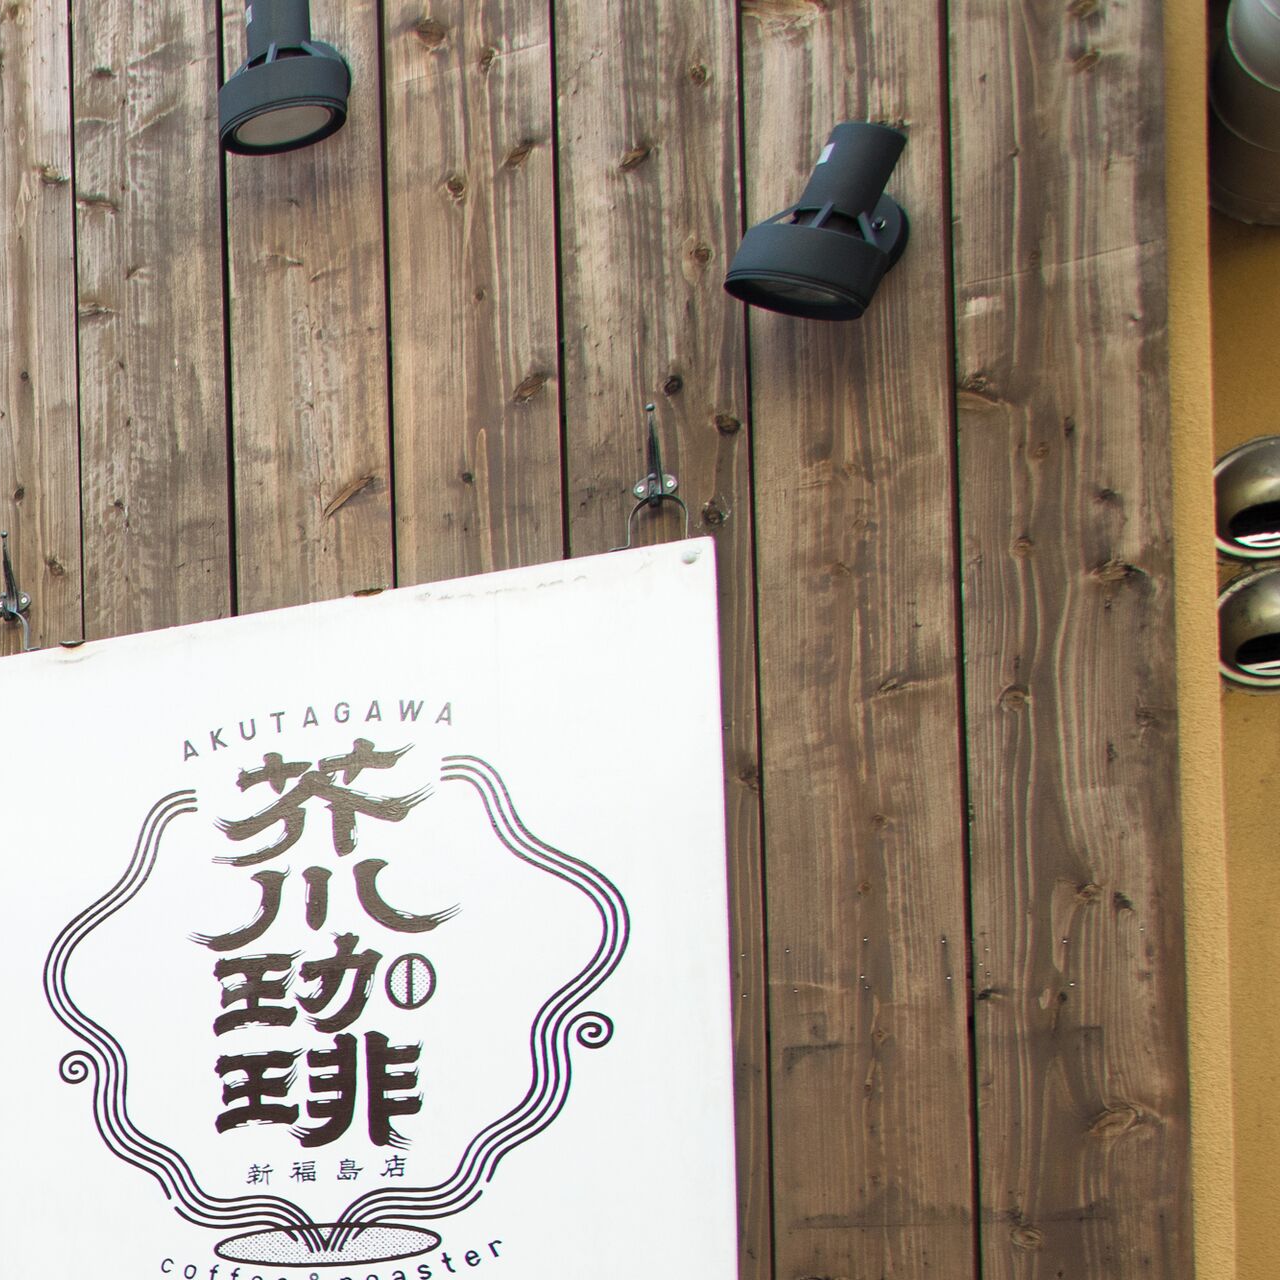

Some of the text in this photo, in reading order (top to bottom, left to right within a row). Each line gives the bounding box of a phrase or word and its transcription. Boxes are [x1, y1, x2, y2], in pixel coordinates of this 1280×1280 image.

[182, 699, 455, 762] AKUTAGAWA
[246, 1154, 408, 1186] 新福島店
